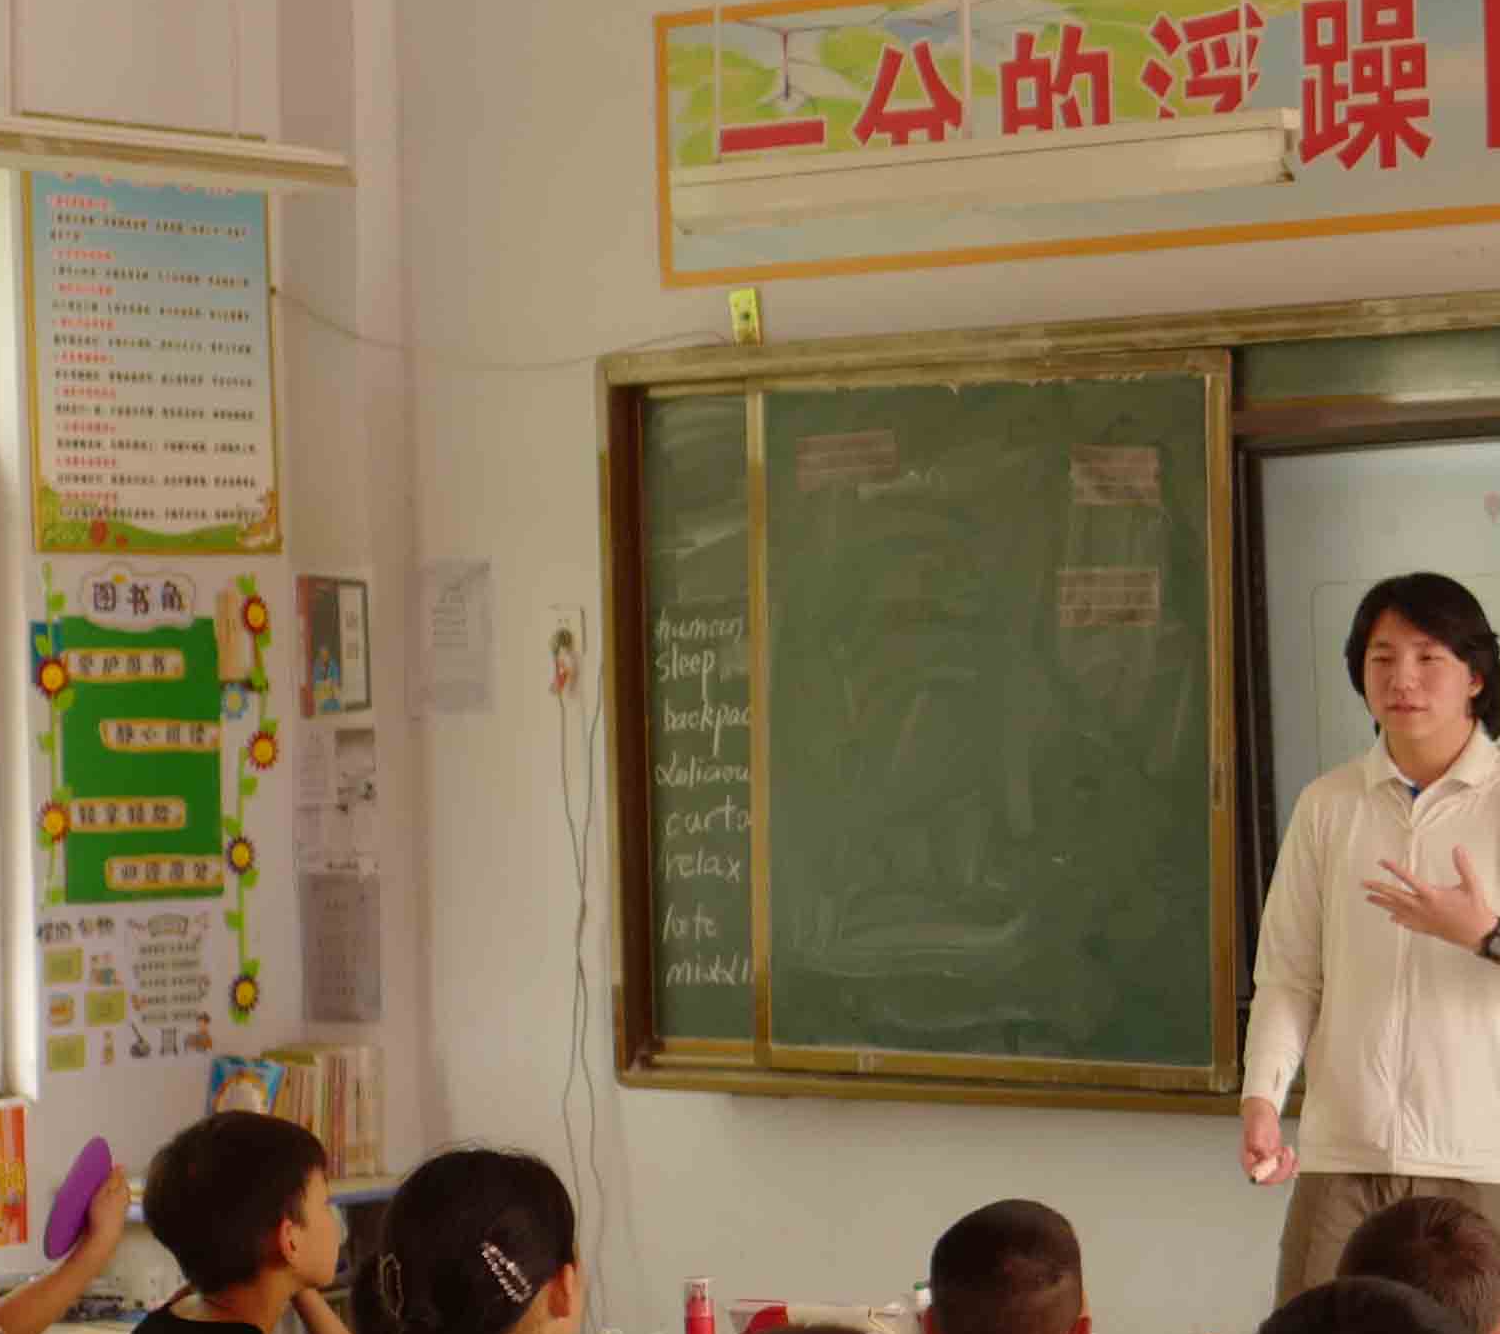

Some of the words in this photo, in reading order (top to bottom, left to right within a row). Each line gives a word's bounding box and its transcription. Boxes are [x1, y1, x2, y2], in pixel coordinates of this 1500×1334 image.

[92, 581, 185, 615] 图书角
[665, 846, 742, 883] relax
